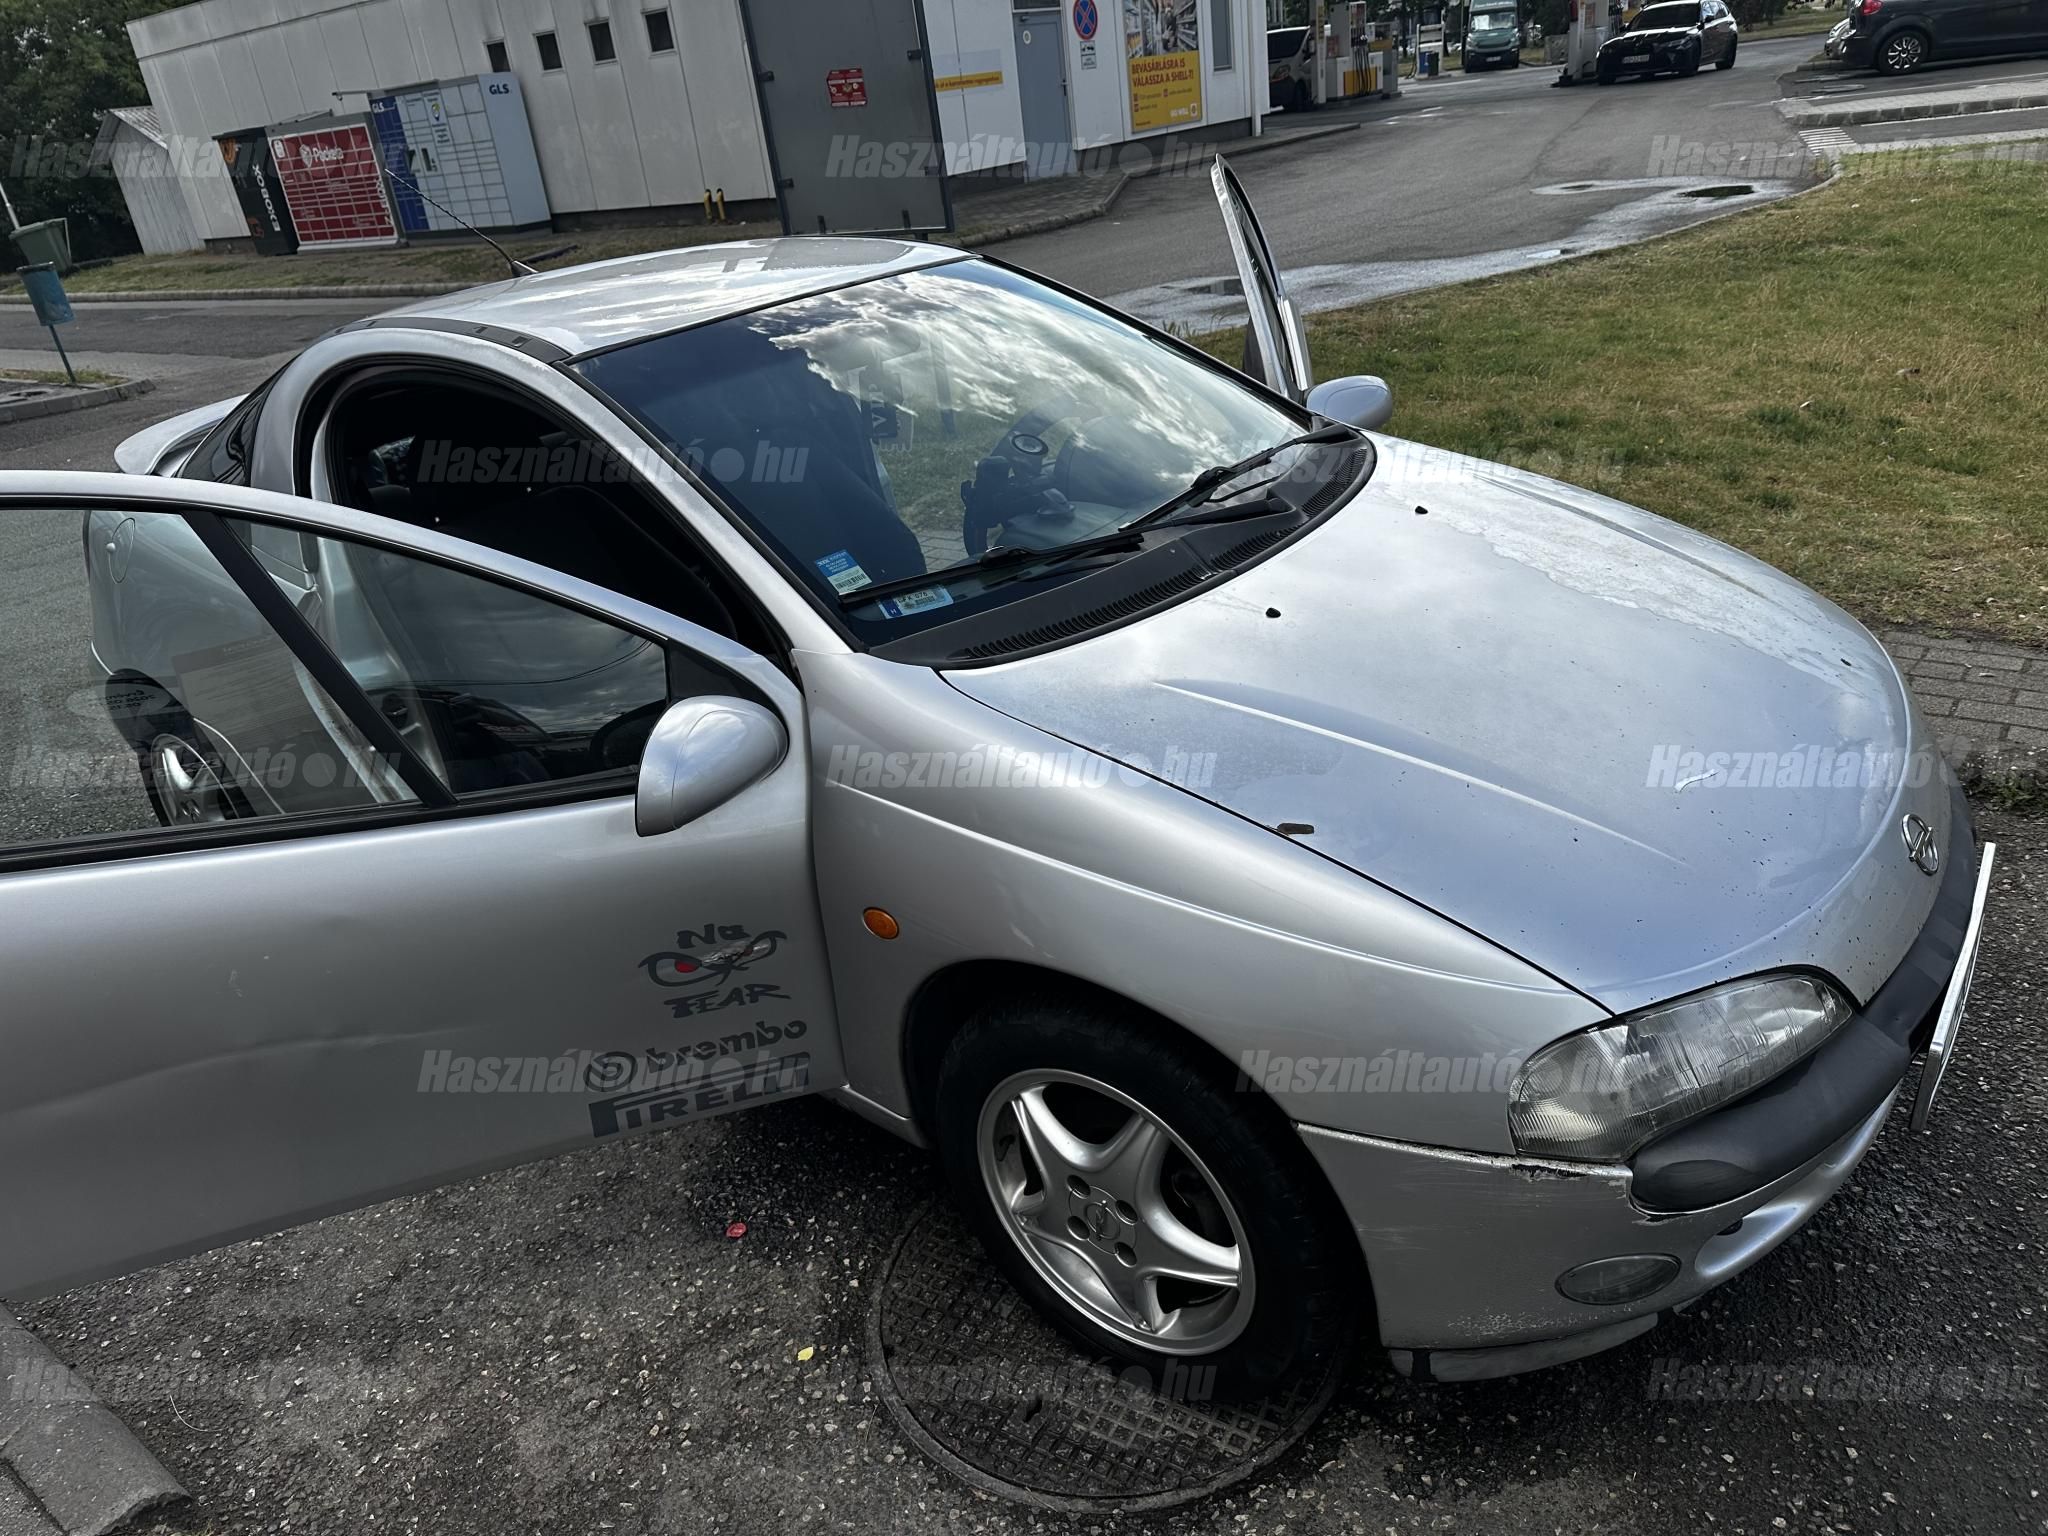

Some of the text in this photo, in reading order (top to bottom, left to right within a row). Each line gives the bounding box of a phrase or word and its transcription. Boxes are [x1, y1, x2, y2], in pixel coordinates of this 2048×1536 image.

[489, 83, 510, 95] GLS
[372, 102, 385, 113] GLS
[664, 983, 792, 1019] FEAR
[645, 1020, 807, 1074] brembo
